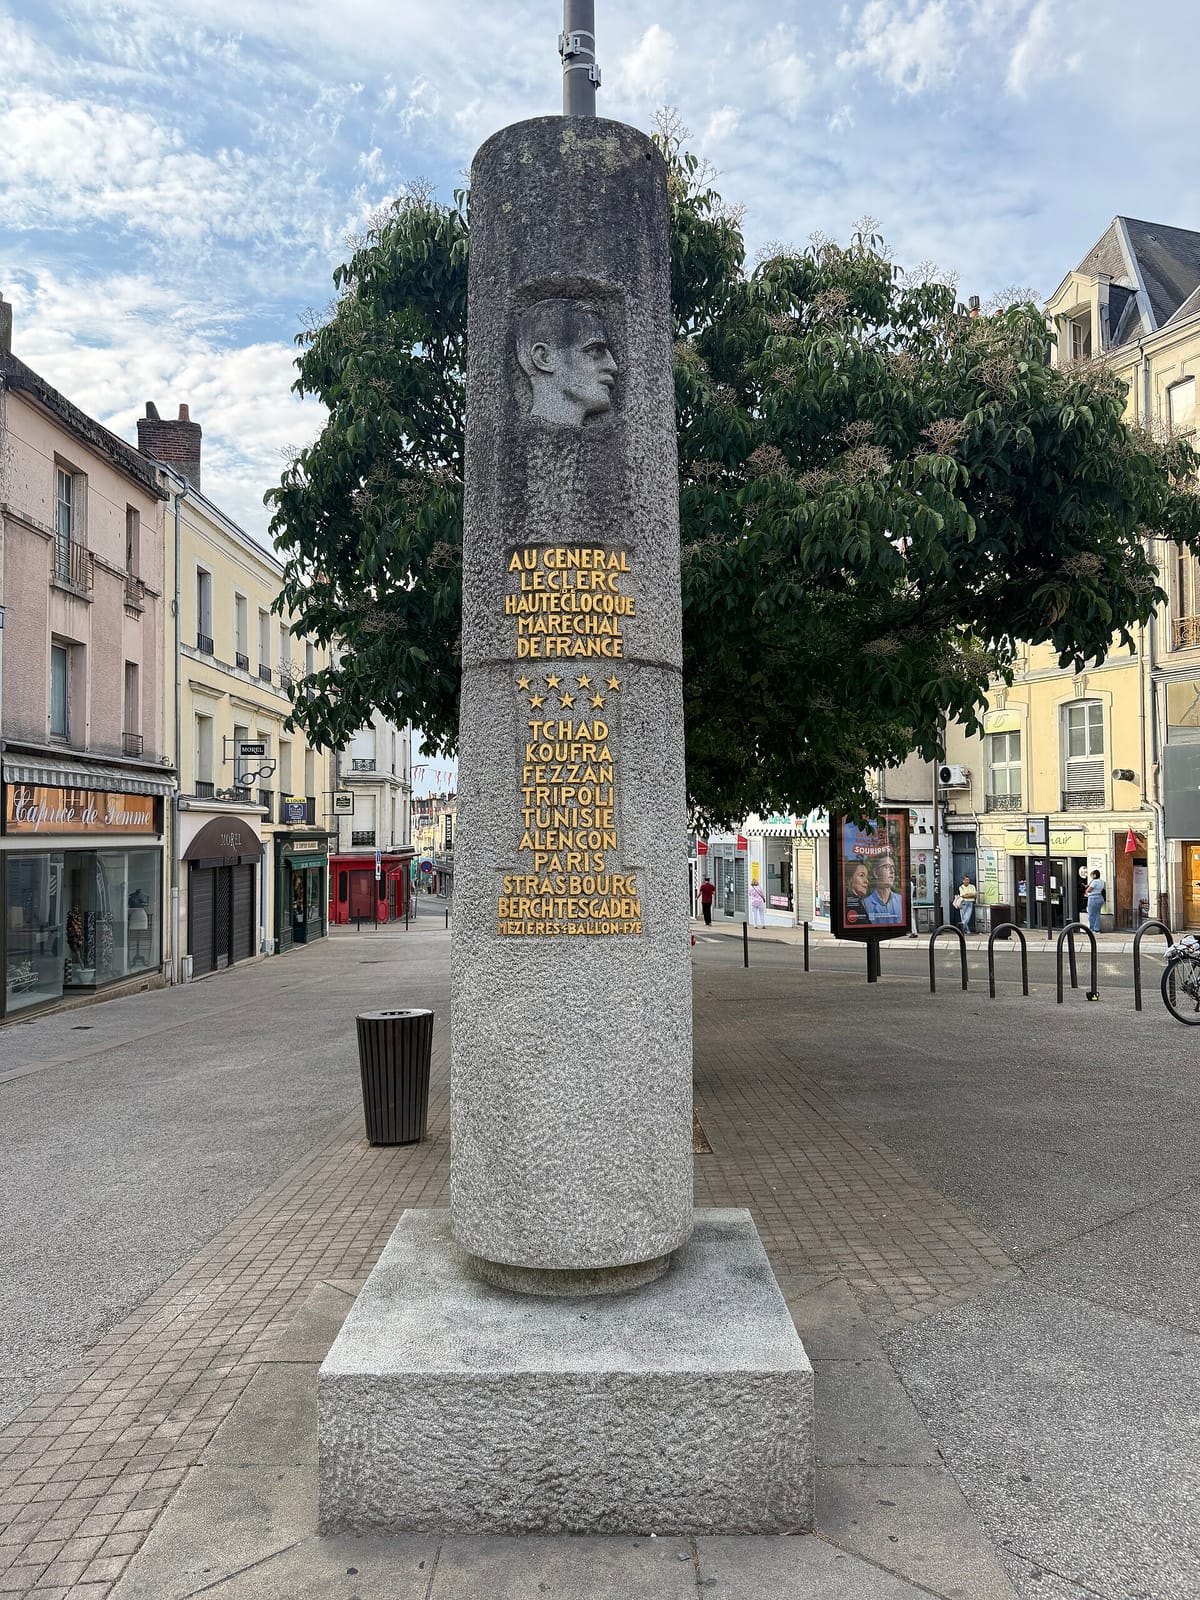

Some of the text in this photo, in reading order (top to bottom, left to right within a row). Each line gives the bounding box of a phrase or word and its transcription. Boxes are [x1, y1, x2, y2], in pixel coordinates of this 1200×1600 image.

[508, 548, 631, 572] AU GENERAL
[520, 570, 619, 592] LECLERC
[505, 593, 636, 616] HAUTECLOCQUE
[518, 615, 623, 636] MARECHAL
[517, 637, 624, 658] DE FRANCE
[528, 720, 609, 741] TCHAD
[241, 746, 263, 754] MOREL
[525, 743, 613, 763] KOUFRA
[522, 764, 614, 784] FEZZAN
[520, 786, 614, 806] TRIPOLI
[13, 789, 151, 832] Caprice de Femme
[520, 808, 615, 829] TUNISIE
[220, 832, 242, 851] MOREL
[534, 852, 606, 872] PARIS
[502, 874, 637, 896] STRASBOURG
[498, 897, 641, 919] BERCHTESGADEN
[497, 922, 560, 935] MEZIERES
